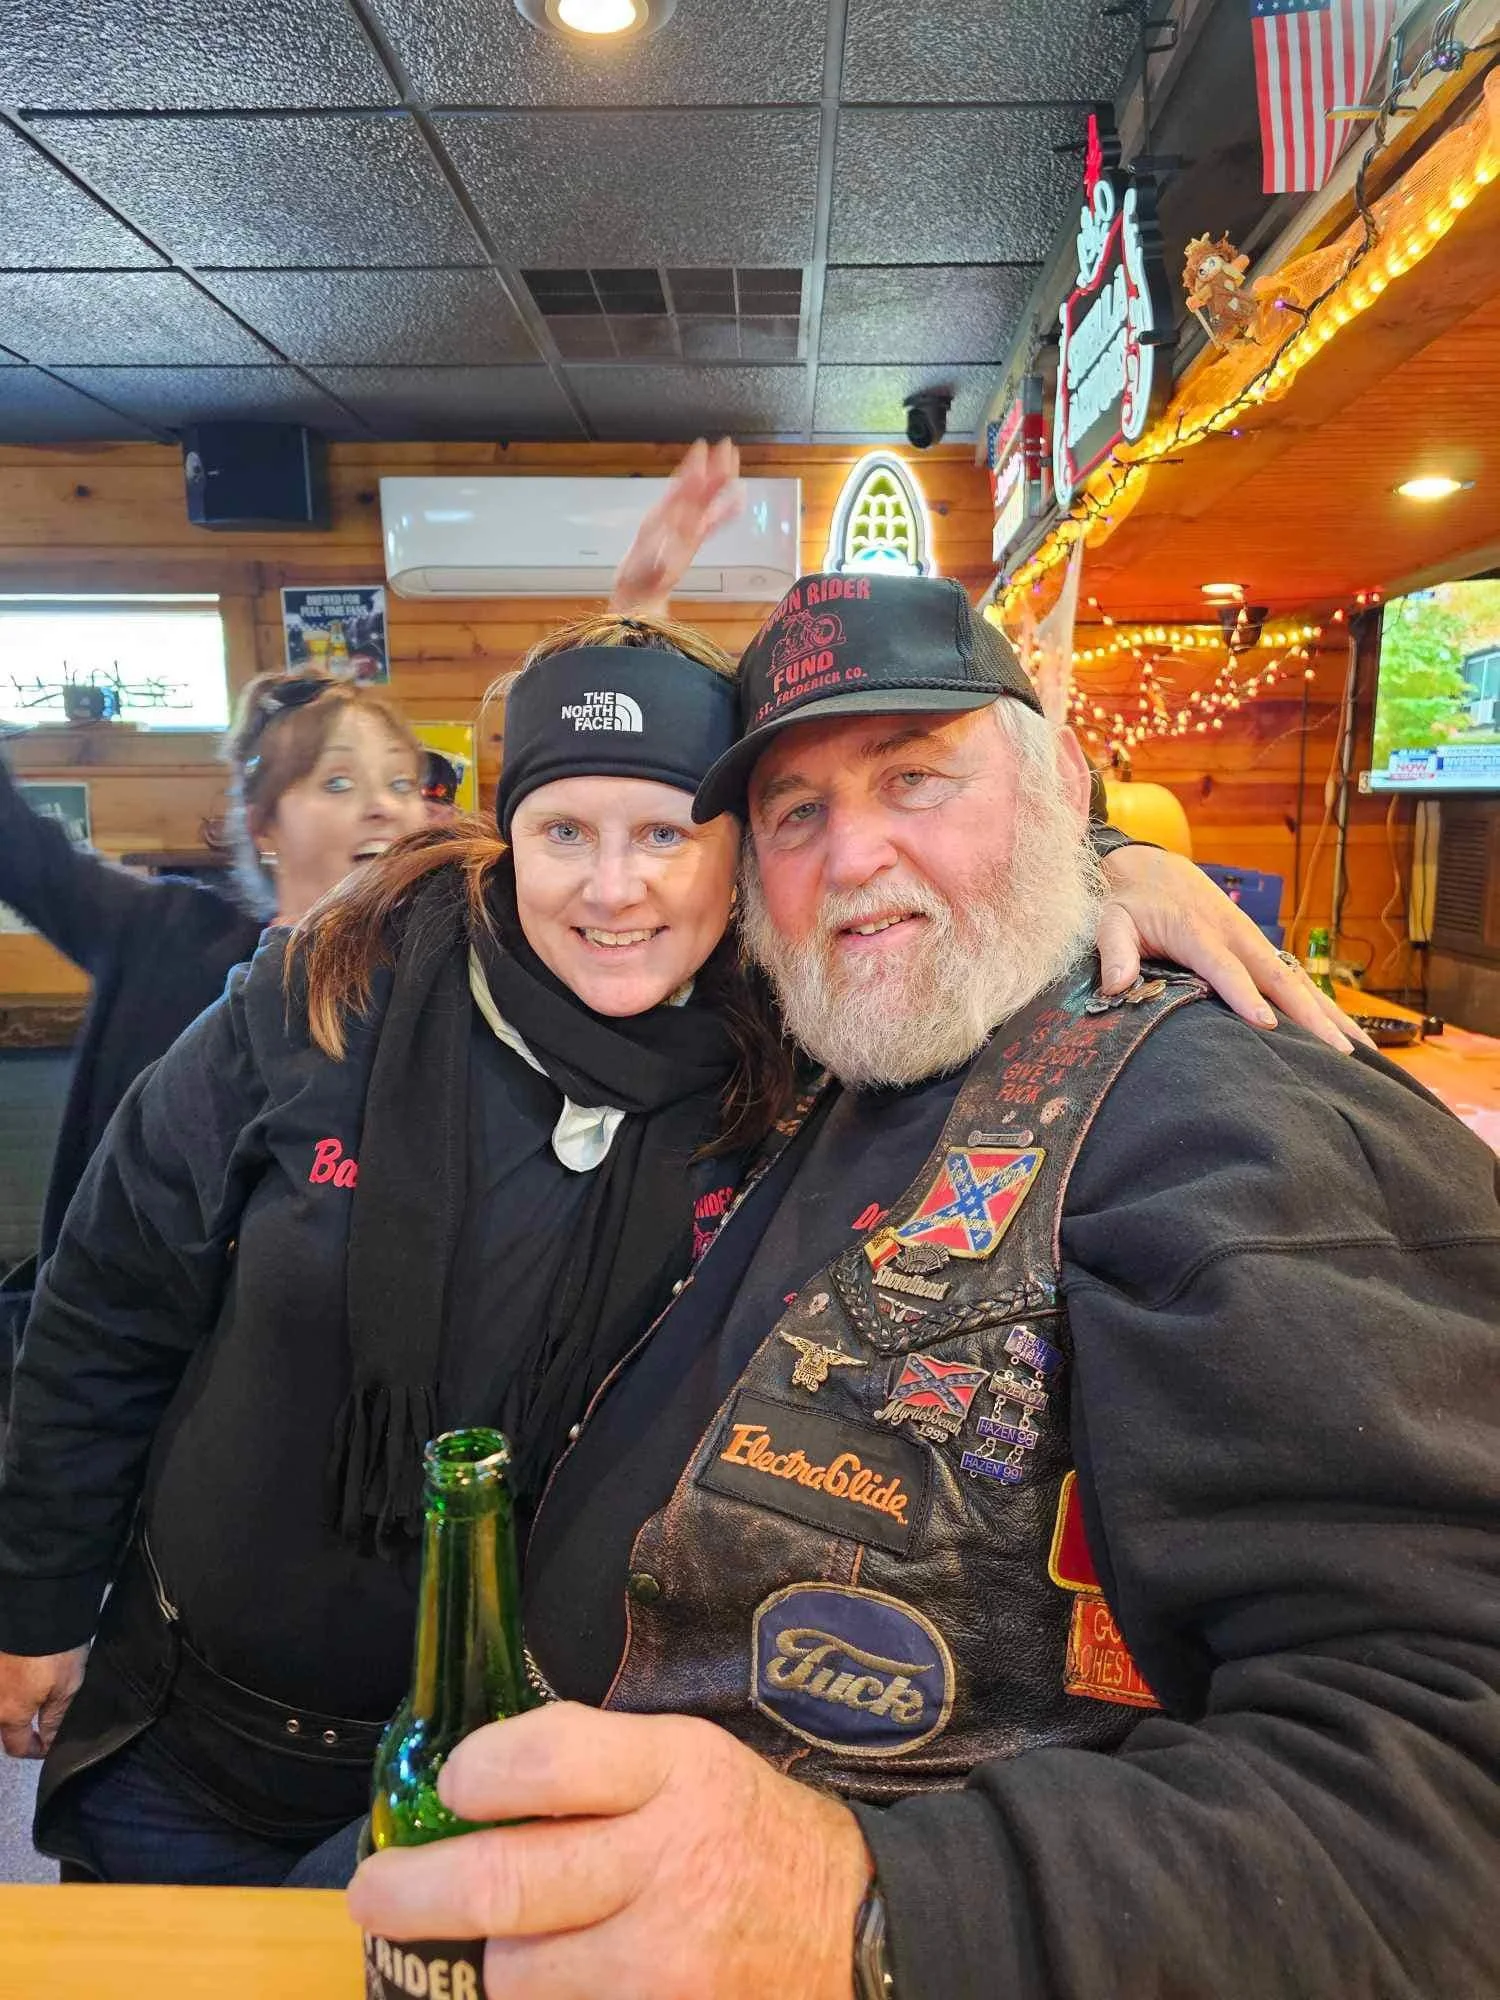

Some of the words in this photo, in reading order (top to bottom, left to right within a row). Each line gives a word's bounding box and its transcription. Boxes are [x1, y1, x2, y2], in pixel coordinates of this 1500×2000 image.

[807, 576, 872, 606] RIDER
[773, 650, 834, 694] FUND
[584, 692, 615, 704] THE
[775, 671, 841, 707] FREDERICK
[845, 666, 869, 682] CO.
[561, 704, 614, 720] NORTH
[574, 717, 613, 731] FACE
[916, 1423, 949, 1444] 1999
[979, 1418, 1017, 1442] HAZEN
[1017, 1430, 1035, 1447] 98
[963, 1453, 1001, 1475] HAZEN
[374, 1935, 479, 2000] RIDER
